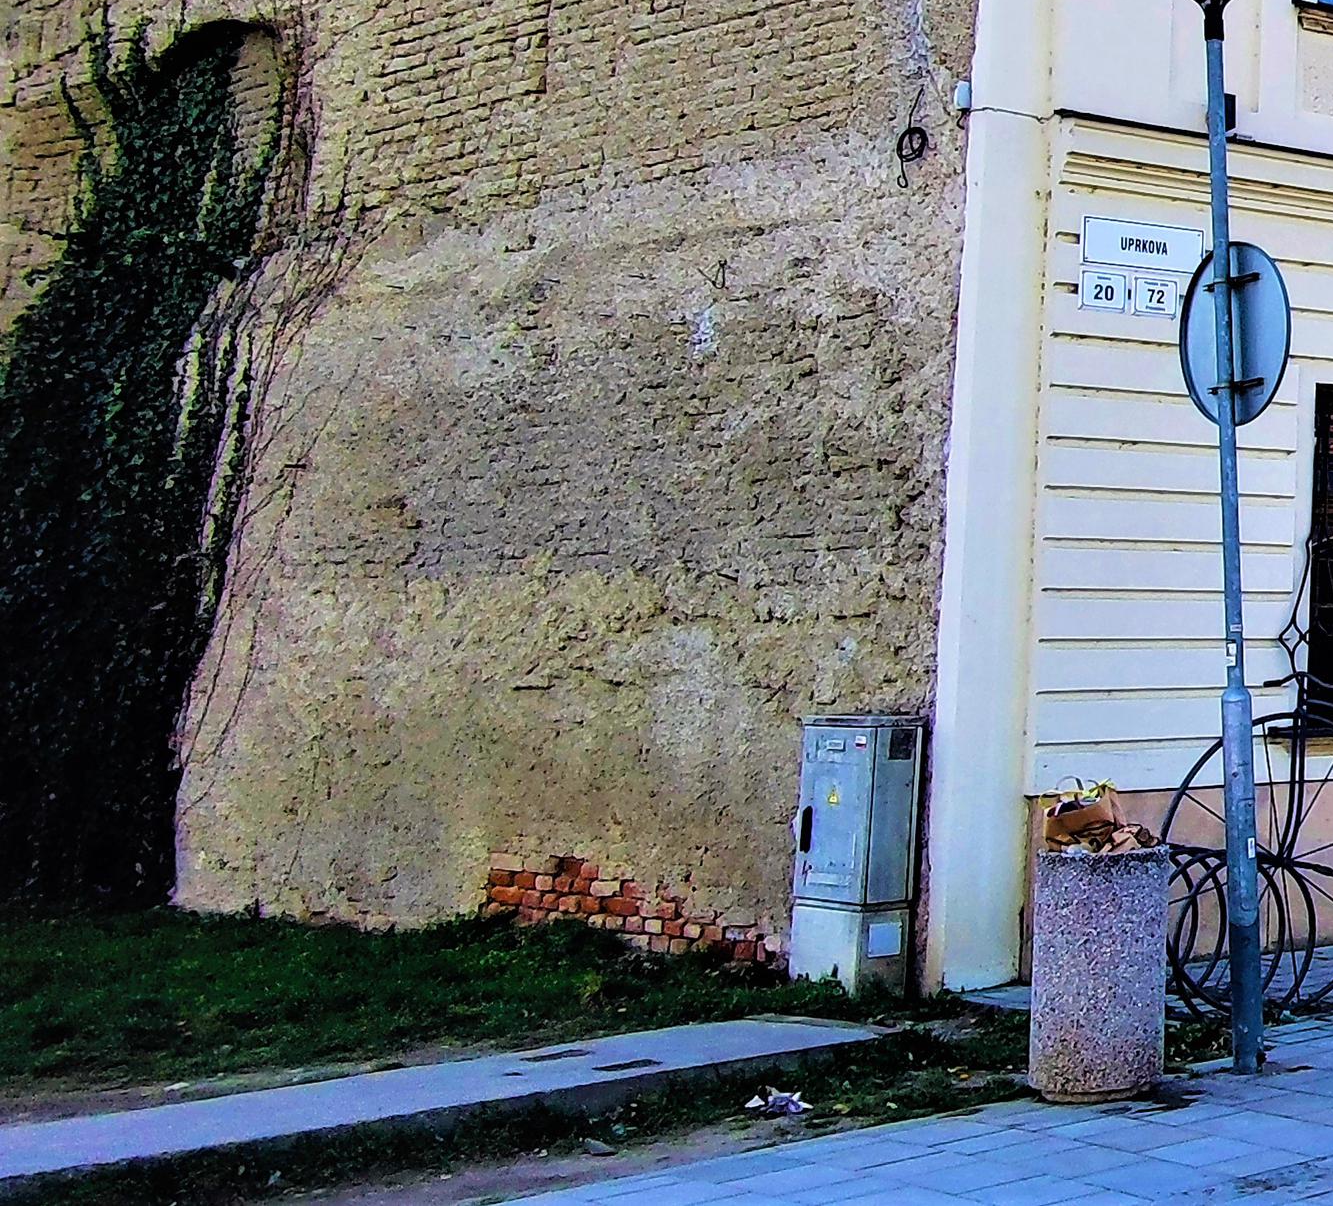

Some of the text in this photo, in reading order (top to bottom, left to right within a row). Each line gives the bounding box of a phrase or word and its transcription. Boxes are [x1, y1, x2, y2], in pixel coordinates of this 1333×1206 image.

[1120, 236, 1168, 256] UPRKOVA
[1093, 284, 1114, 301] 20
[1147, 288, 1165, 305] 72
